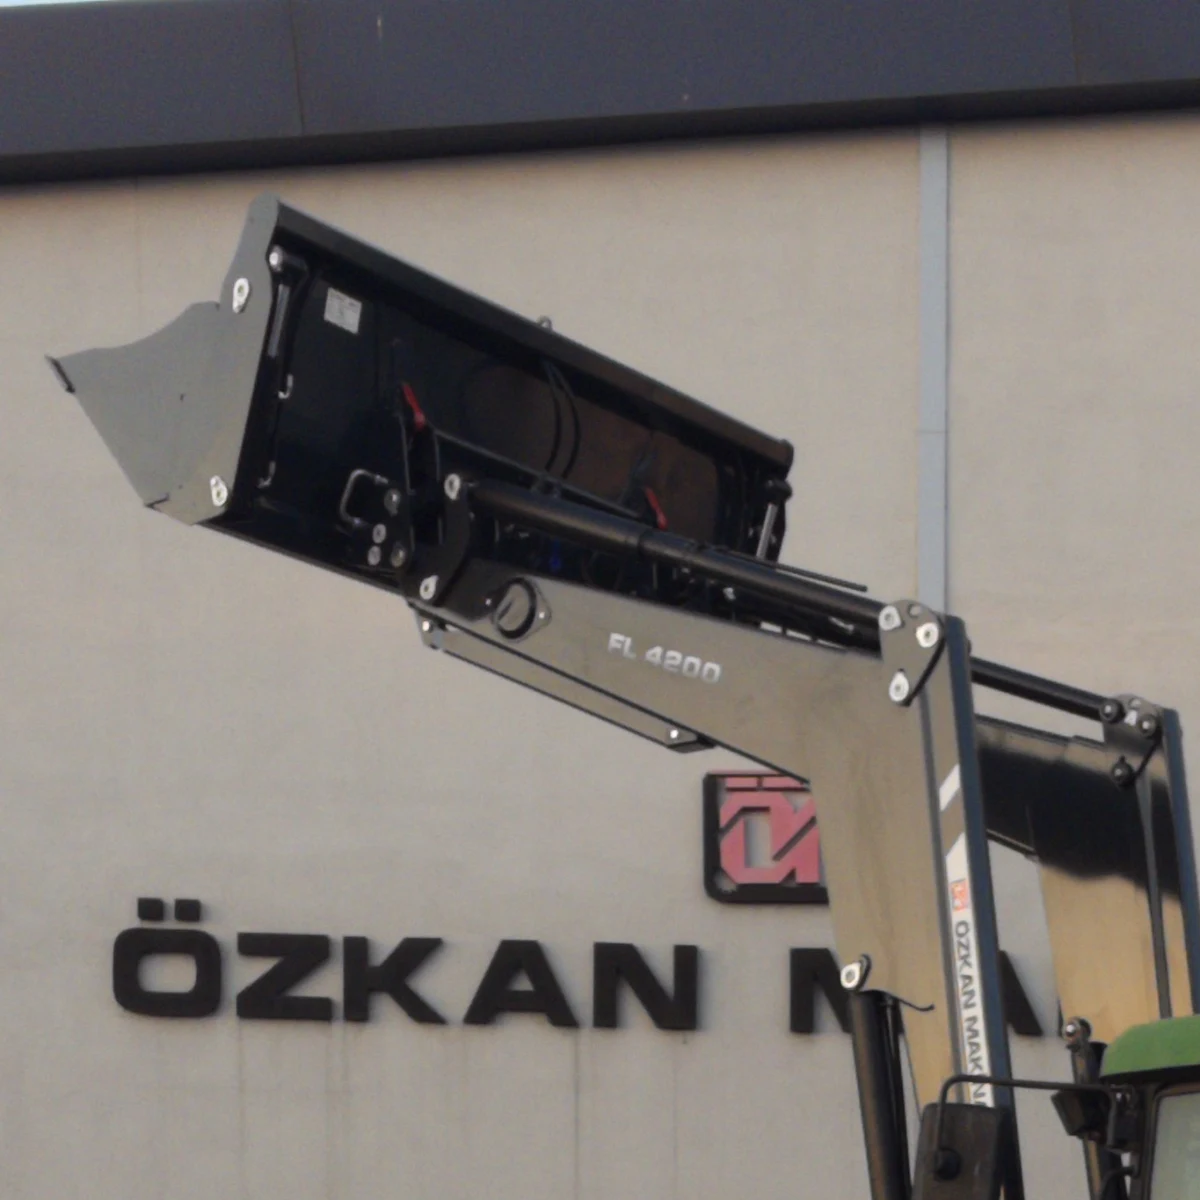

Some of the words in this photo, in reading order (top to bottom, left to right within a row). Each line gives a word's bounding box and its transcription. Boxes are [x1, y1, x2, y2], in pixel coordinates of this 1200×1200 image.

[608, 631, 637, 660] FL
[645, 645, 722, 685] 4200
[112, 897, 700, 1031] ÖZKAN
[965, 1015, 989, 1106] MAKN
